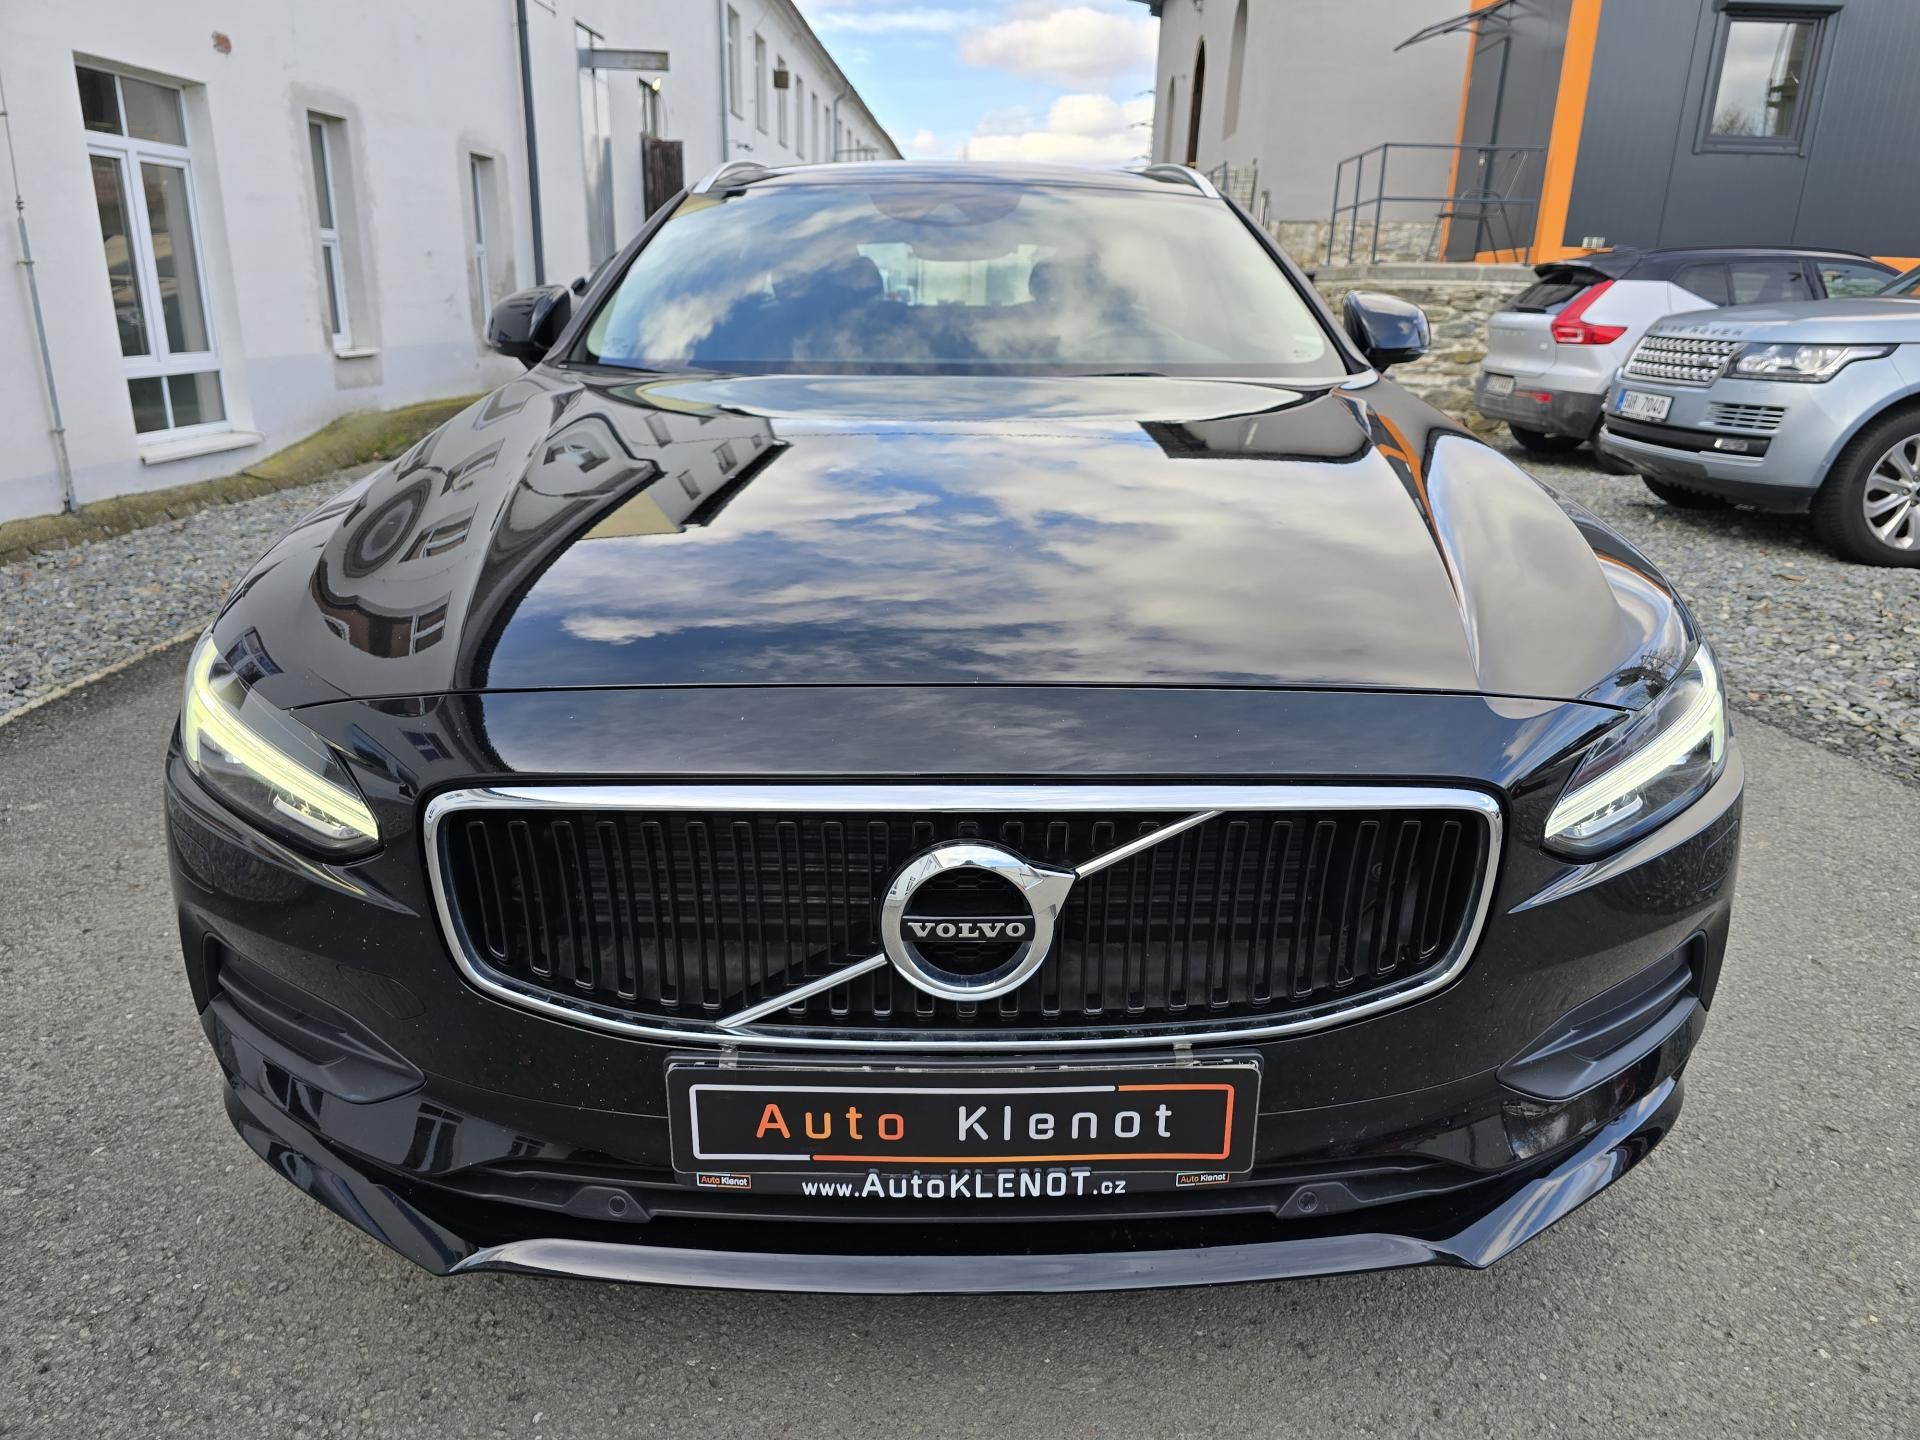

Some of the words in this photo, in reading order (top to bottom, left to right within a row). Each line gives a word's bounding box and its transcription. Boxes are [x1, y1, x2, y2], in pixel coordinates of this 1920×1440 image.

[908, 922, 1026, 938] VOLVO
[756, 1103, 904, 1140] Auto
[958, 1104, 1172, 1141] Klenot
[701, 1175, 720, 1184] Auto
[721, 1176, 748, 1186] Klenot
[802, 1172, 1126, 1199] www.AutoKLENOT.cz
[1180, 1175, 1199, 1183] Auto
[1200, 1173, 1226, 1182] Klenot
